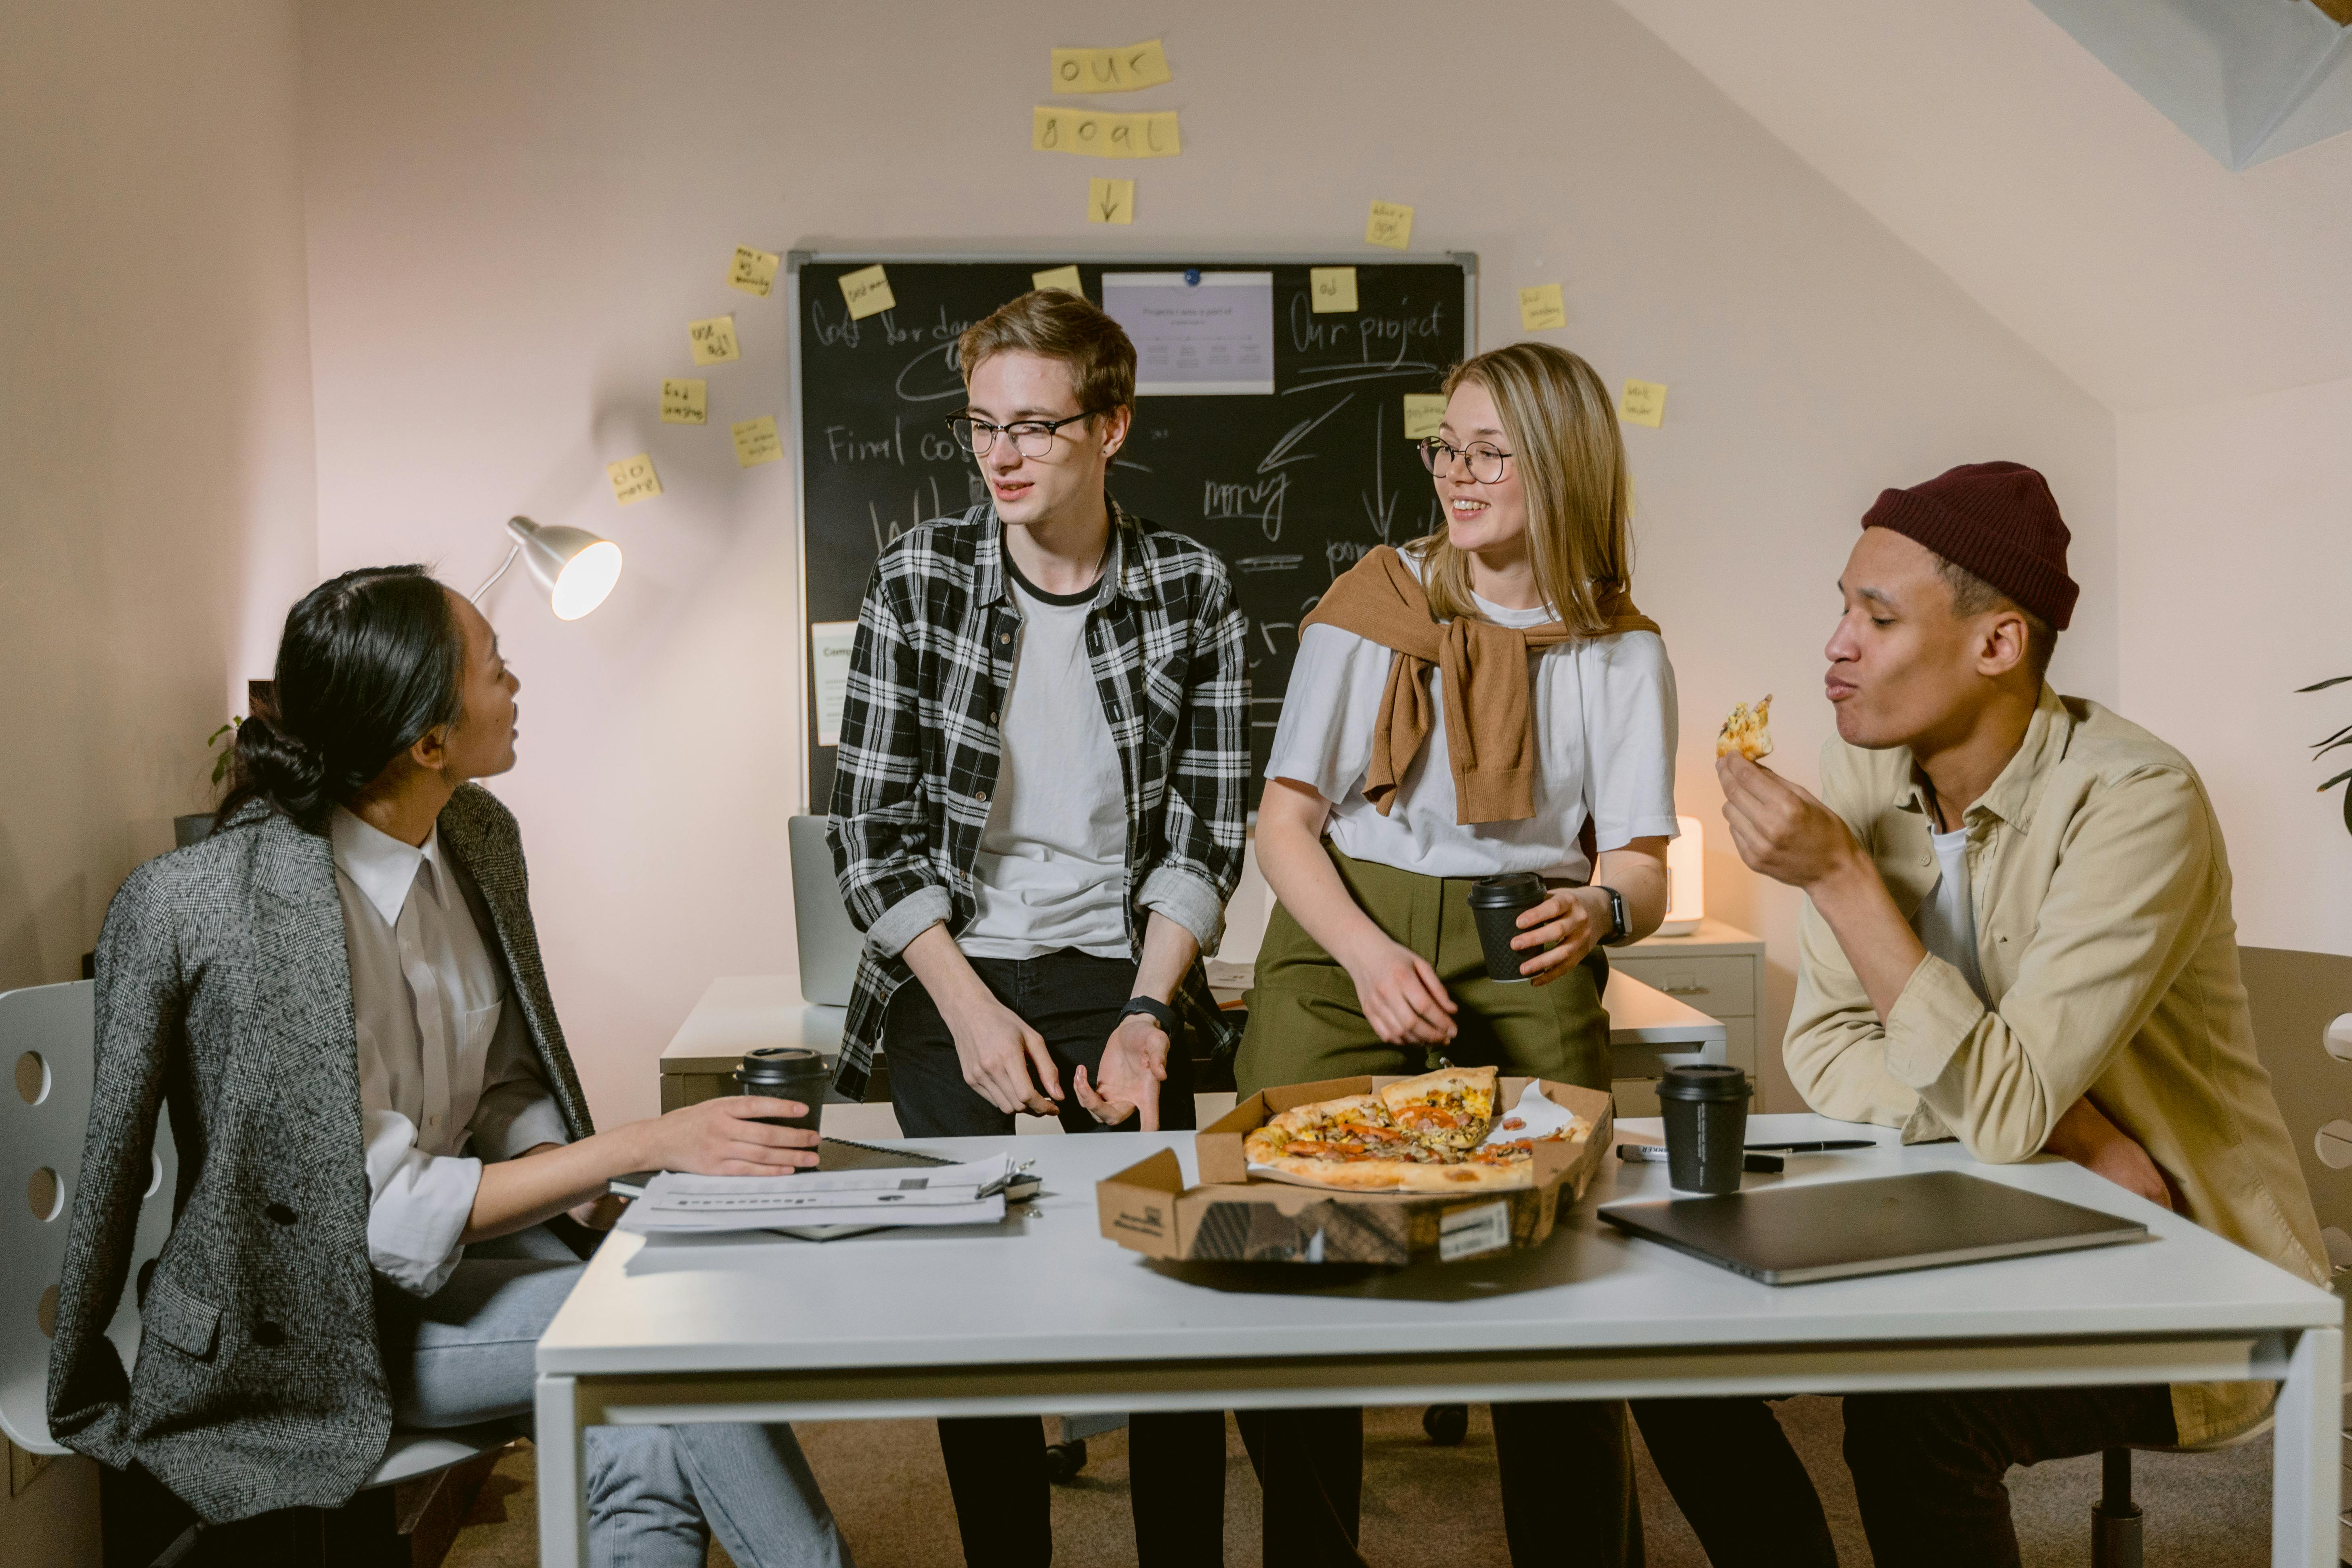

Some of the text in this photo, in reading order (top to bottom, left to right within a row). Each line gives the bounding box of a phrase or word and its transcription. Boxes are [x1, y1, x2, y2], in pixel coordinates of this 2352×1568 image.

[1060, 52, 1146, 83] our
[1041, 118, 1163, 152] goal
[1291, 292, 1443, 370] Our project
